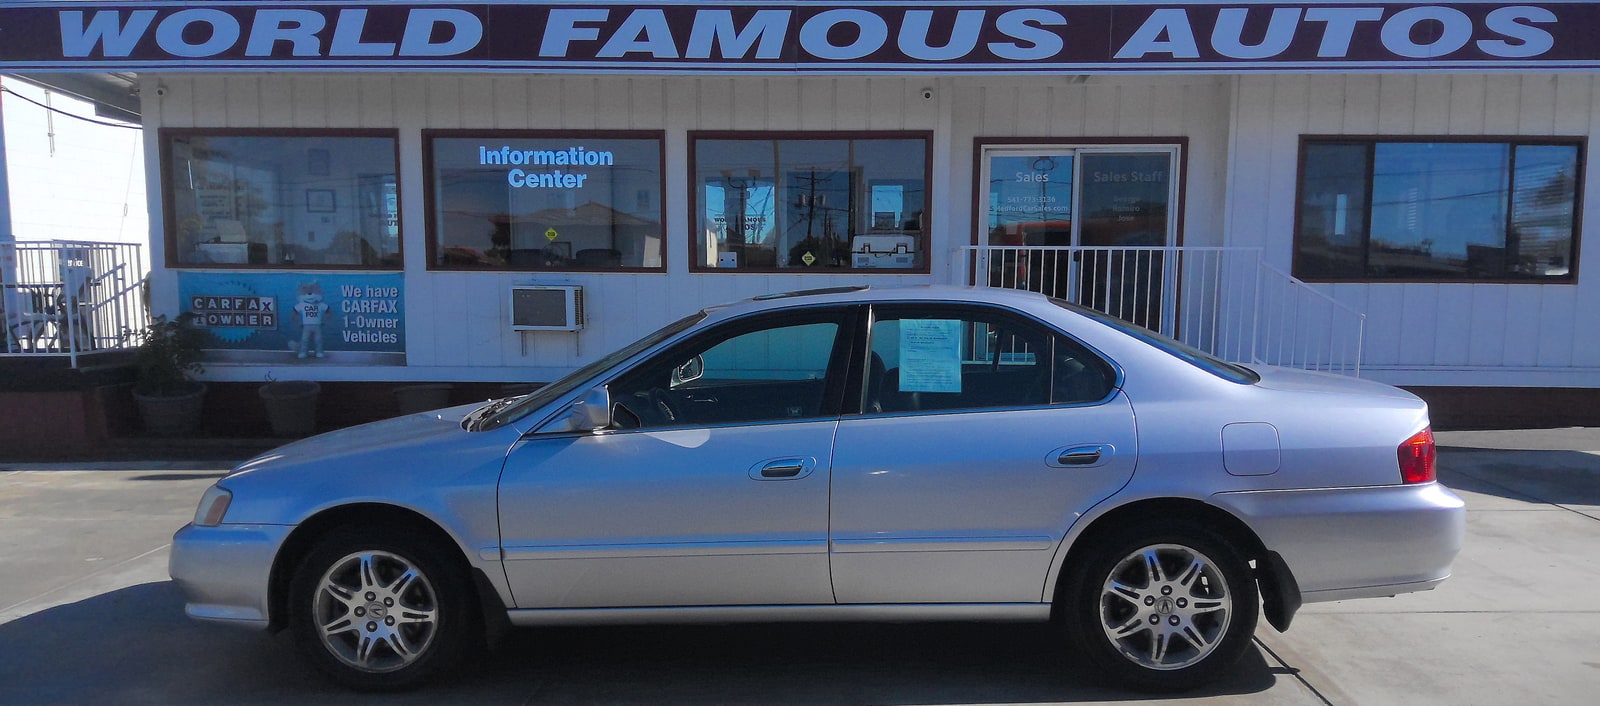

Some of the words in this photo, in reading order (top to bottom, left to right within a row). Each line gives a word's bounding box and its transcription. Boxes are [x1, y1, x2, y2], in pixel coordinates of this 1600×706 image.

[58, 8, 484, 58] WORLD
[538, 8, 1068, 61] FAMOUS
[1112, 6, 1559, 59] AUTOS
[479, 146, 614, 166] Information
[508, 169, 587, 188] Center
[1015, 171, 1049, 183] Sales
[1093, 171, 1128, 183] Sales
[1131, 171, 1163, 182] Staff
[341, 285, 361, 298] We
[366, 285, 398, 298] have
[193, 297, 273, 311] CARFAX
[341, 300, 398, 314] CARFAX
[208, 314, 272, 326] OWNER
[343, 316, 398, 329] 1-Owner
[342, 330, 398, 344] Vehicles
